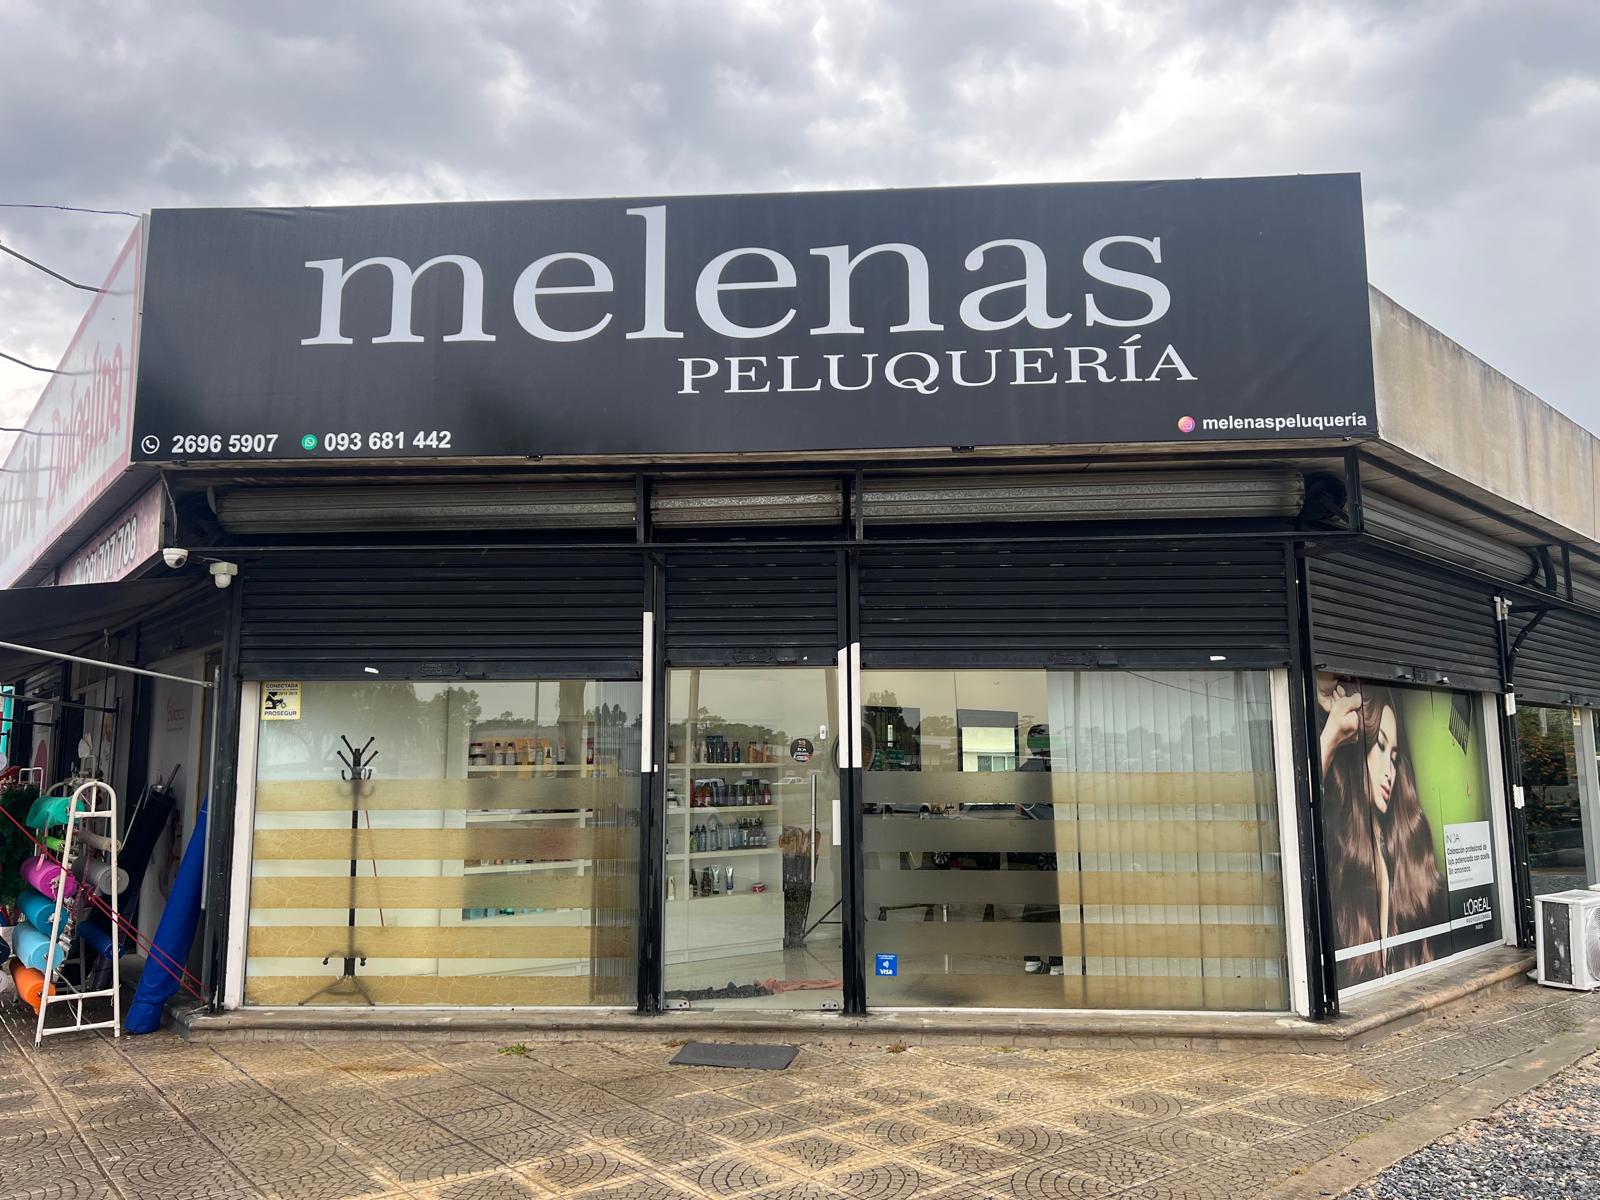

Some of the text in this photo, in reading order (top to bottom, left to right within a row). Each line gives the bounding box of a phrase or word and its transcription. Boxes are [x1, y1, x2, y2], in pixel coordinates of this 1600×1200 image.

[300, 204, 1171, 347] melenas
[677, 333, 1199, 397] PELUQUERÍA
[324, 430, 452, 451] 093 681 442
[1202, 412, 1368, 432] melenaspeluquería
[171, 433, 279, 454] 2696 5907
[99, 533, 116, 581] 707
[117, 515, 138, 572] 708
